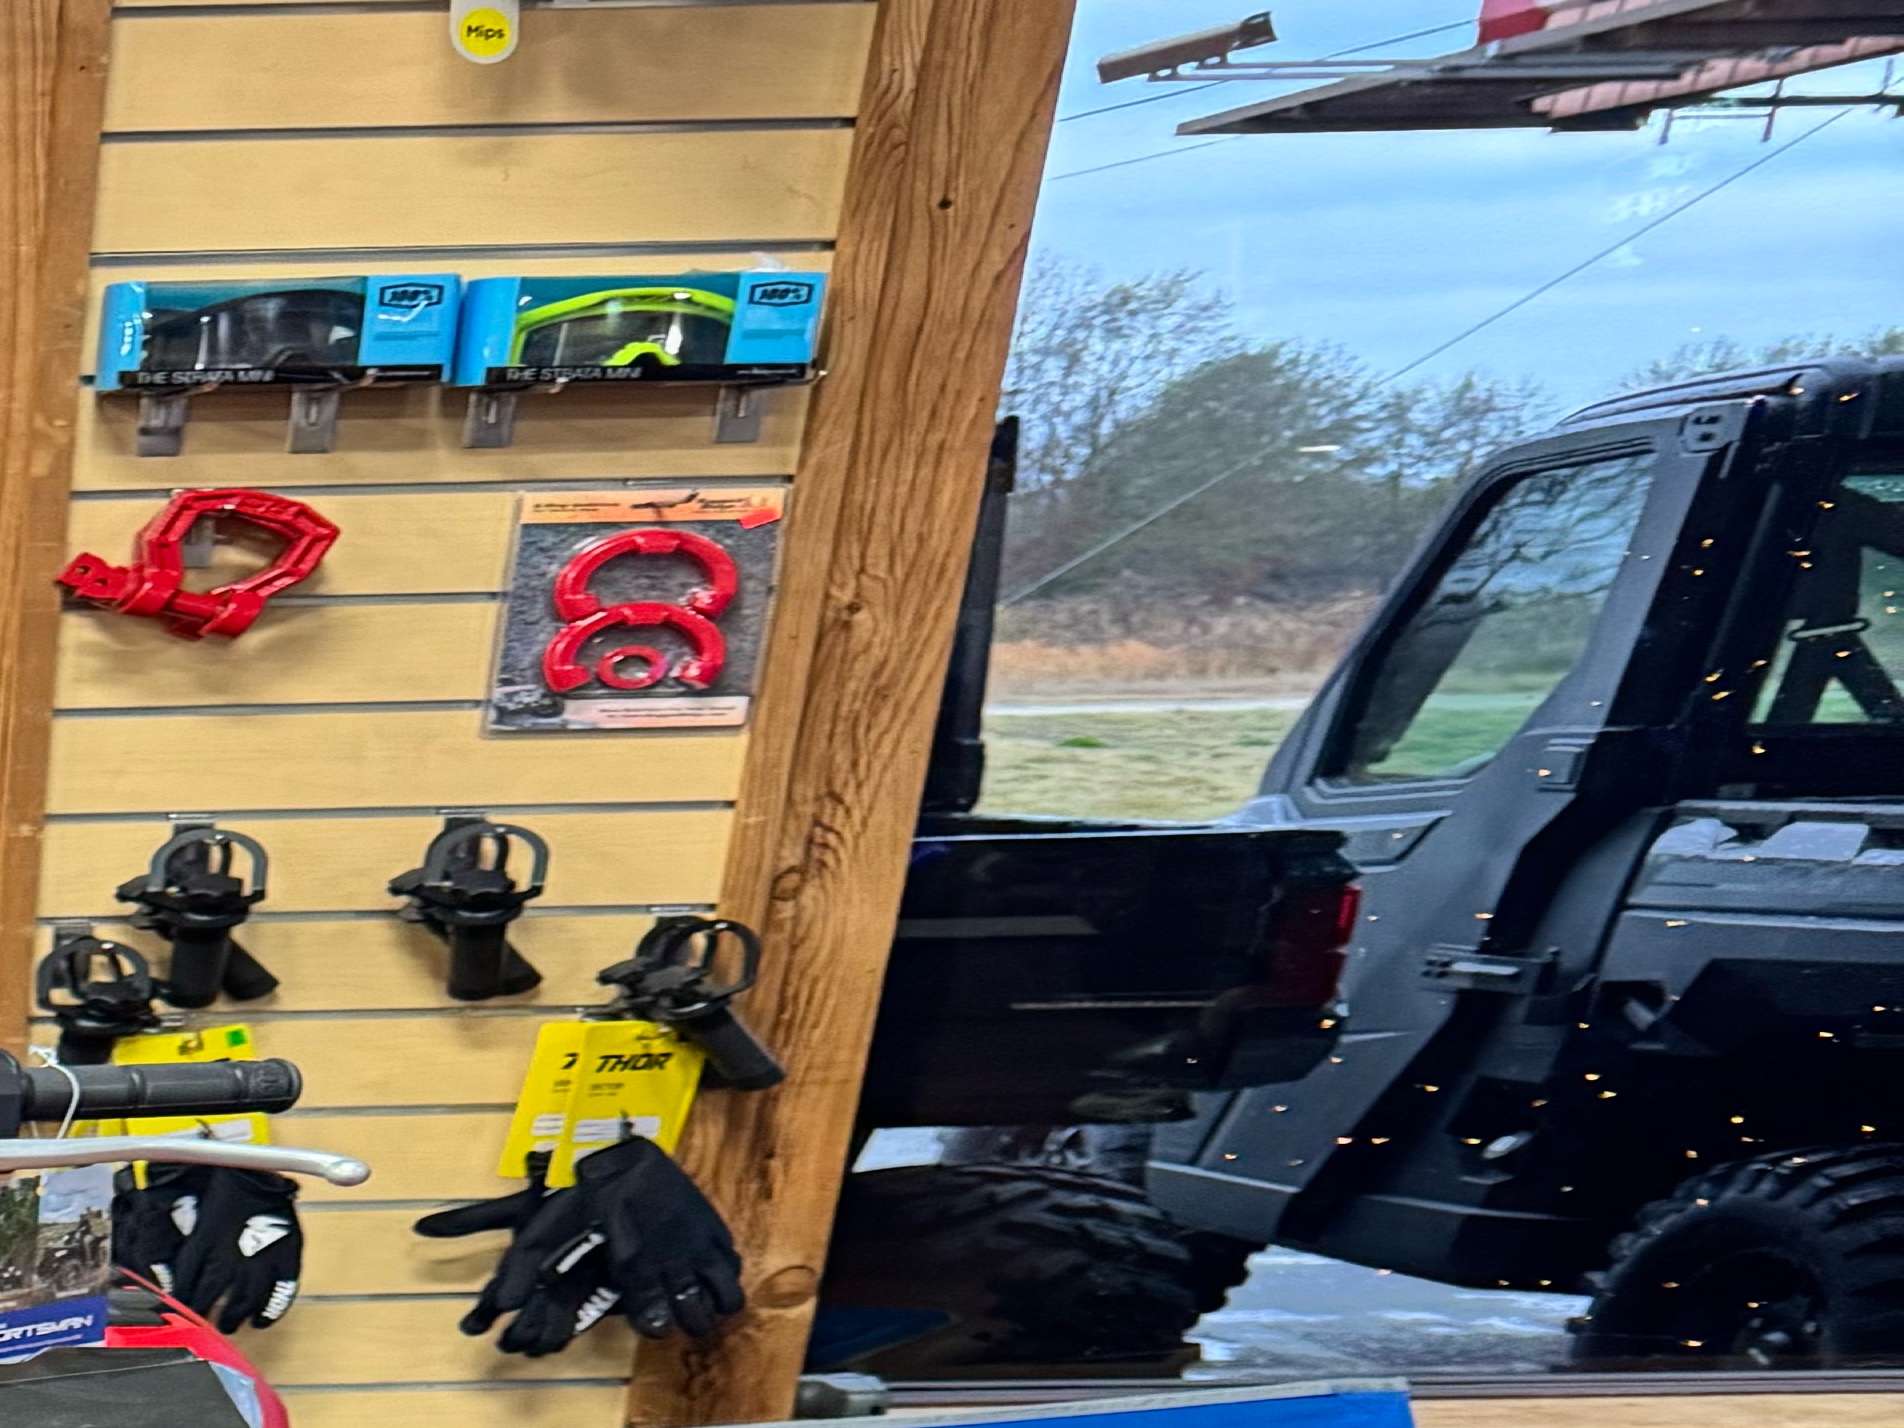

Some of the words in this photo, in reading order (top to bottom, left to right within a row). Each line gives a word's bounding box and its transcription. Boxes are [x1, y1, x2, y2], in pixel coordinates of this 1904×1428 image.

[466, 25, 506, 40] Mips
[507, 368, 538, 381] THE
[596, 1052, 674, 1072] THOR
